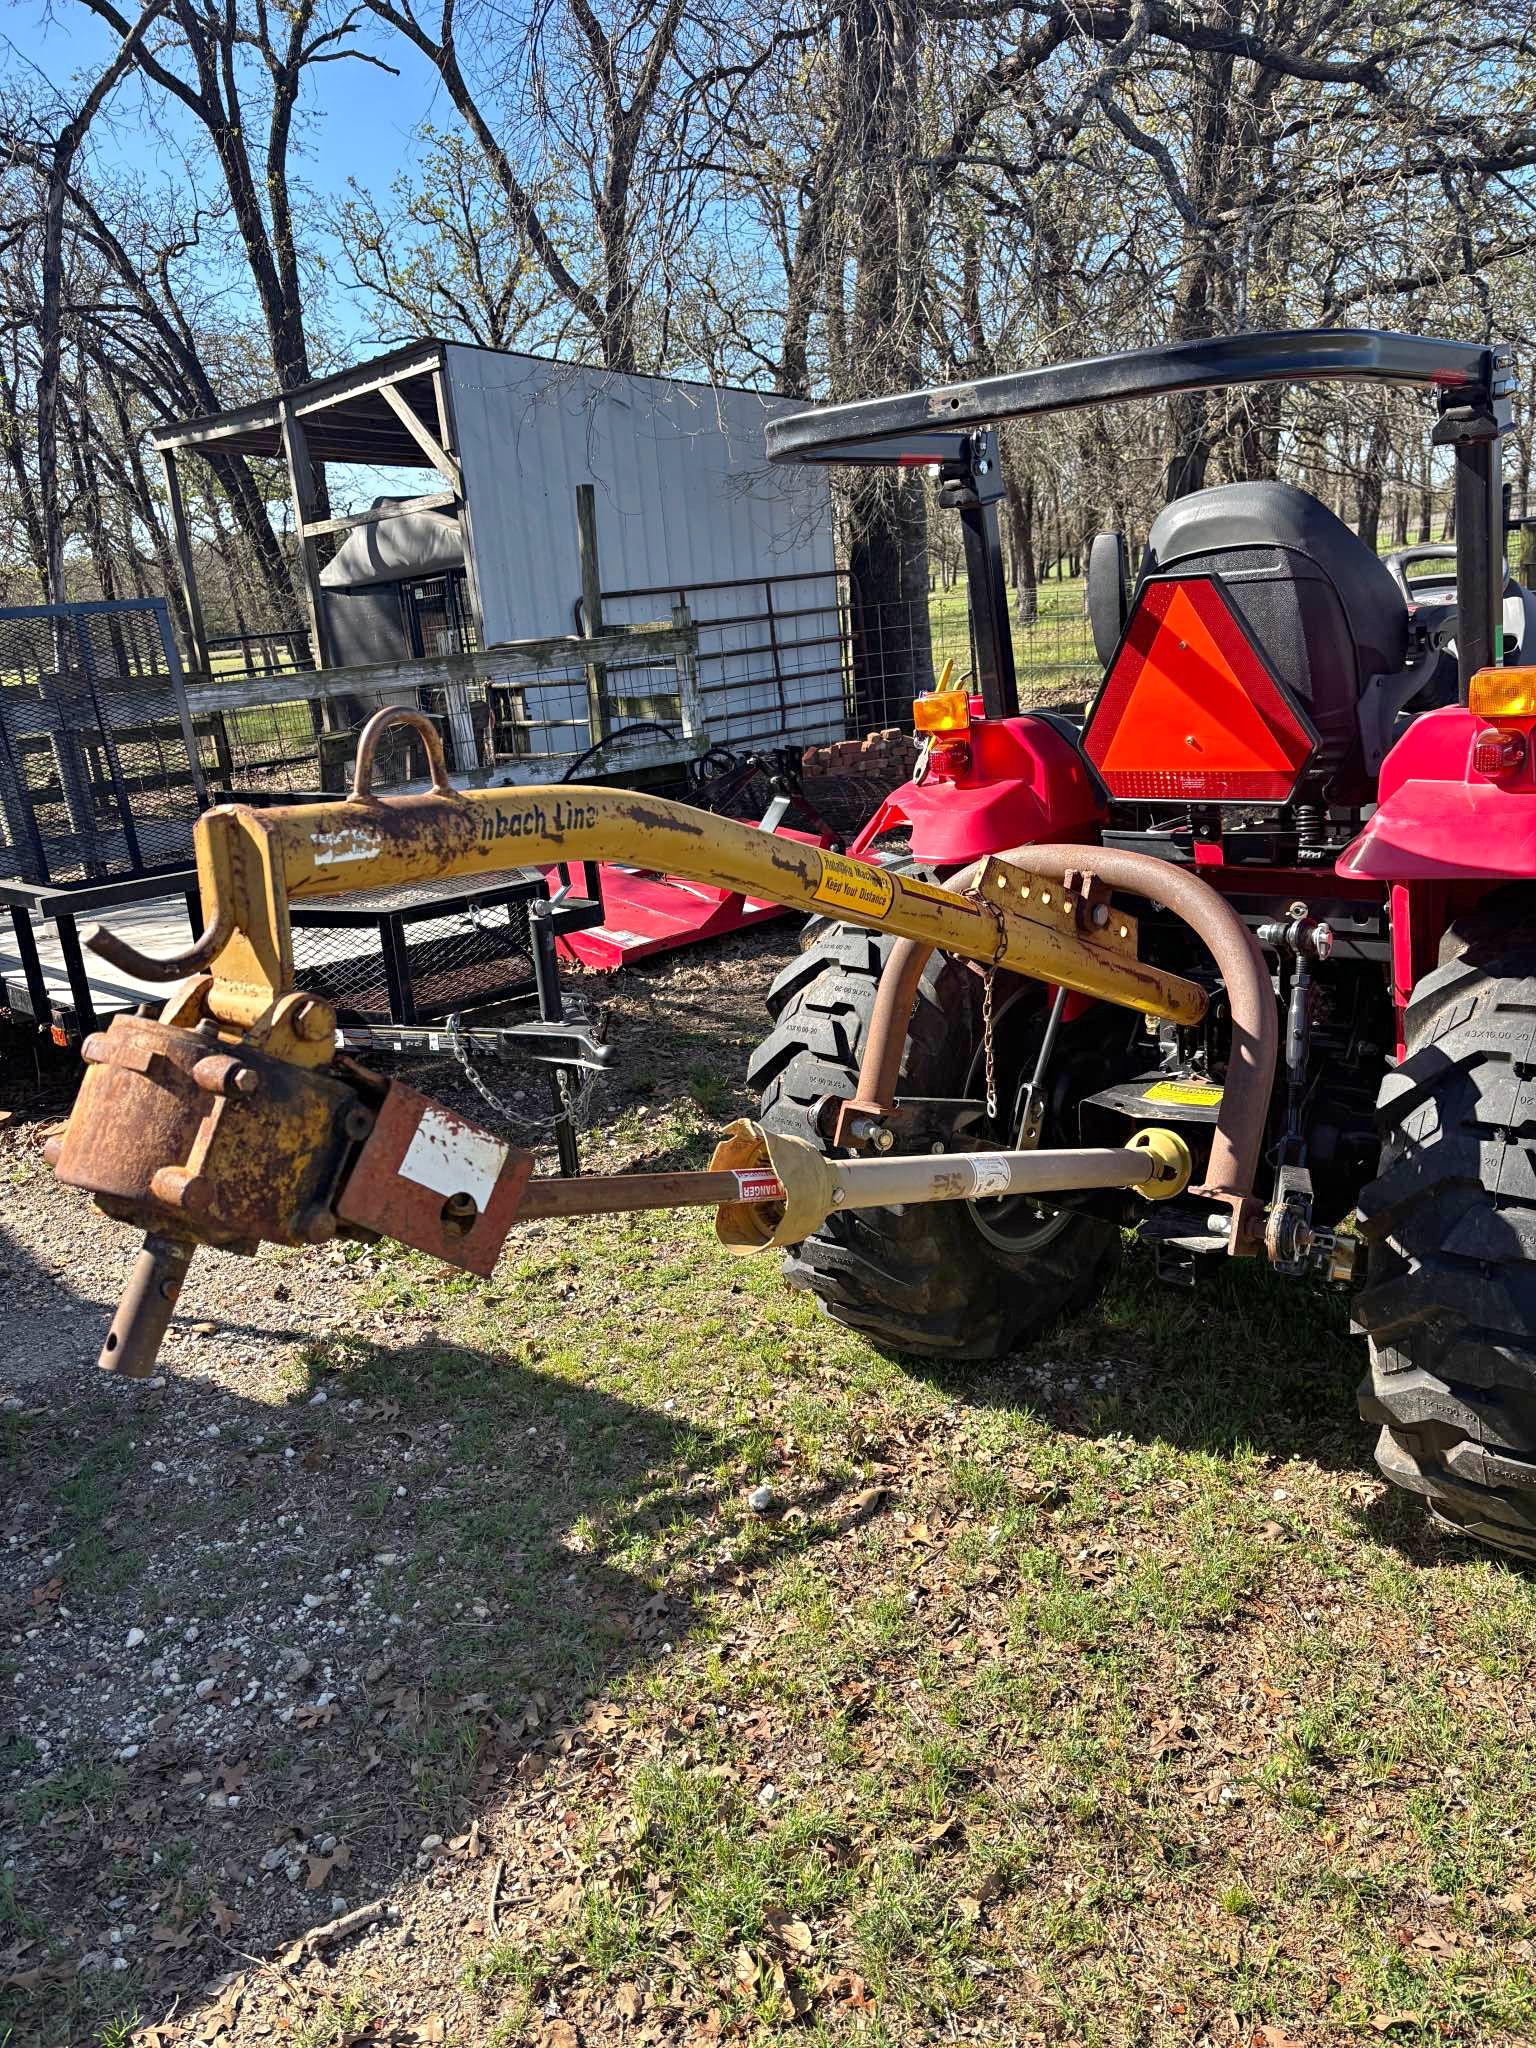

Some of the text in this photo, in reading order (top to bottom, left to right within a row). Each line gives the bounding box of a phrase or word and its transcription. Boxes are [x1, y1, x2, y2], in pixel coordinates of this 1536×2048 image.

[825, 878, 842, 894] Keep
[843, 881, 858, 896] Your
[859, 888, 887, 905] Distance
[743, 1184, 777, 1197] DANGER
